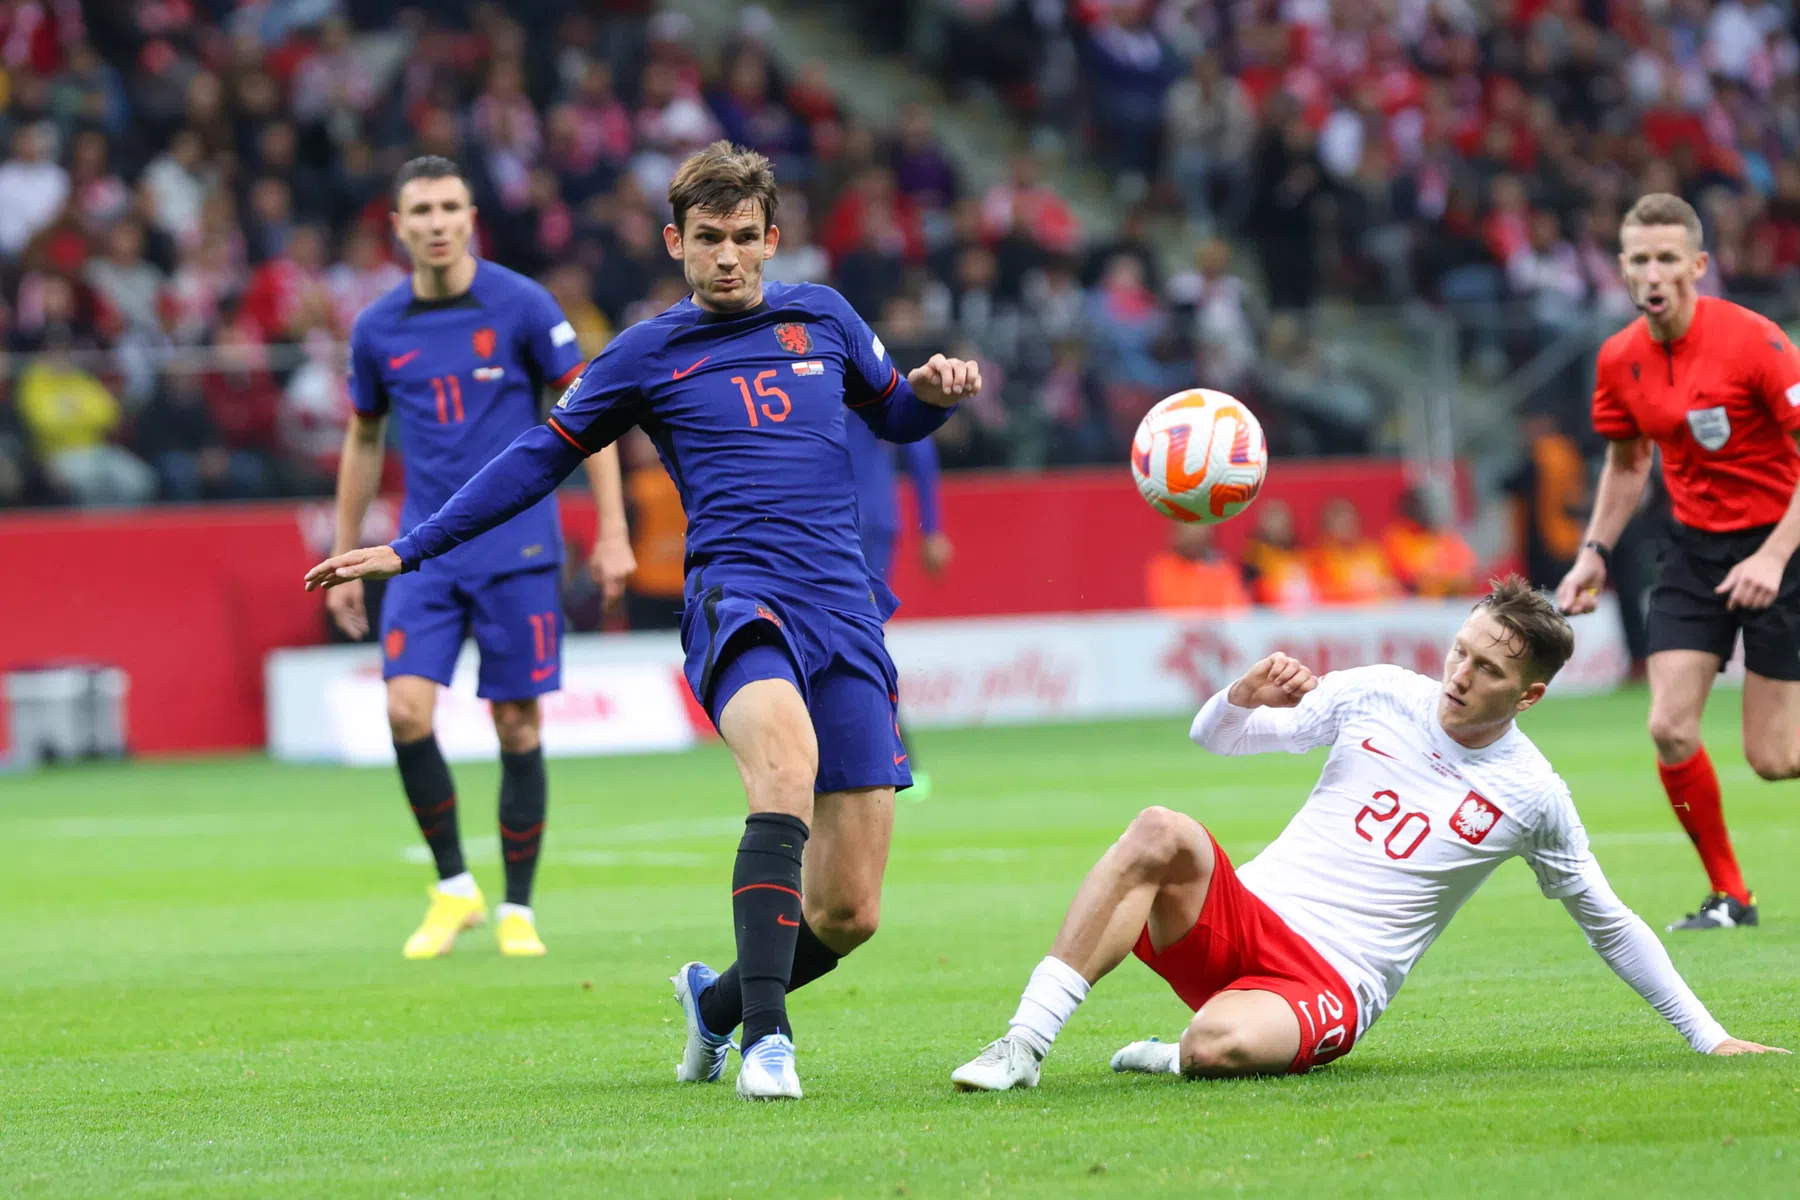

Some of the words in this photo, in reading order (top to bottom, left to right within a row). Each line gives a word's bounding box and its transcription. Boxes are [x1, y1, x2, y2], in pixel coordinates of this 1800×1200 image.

[431, 374, 465, 425] 11
[730, 369, 792, 428] 15
[529, 611, 556, 664] 11
[1354, 789, 1431, 860] 20
[1315, 989, 1347, 1056] 20
